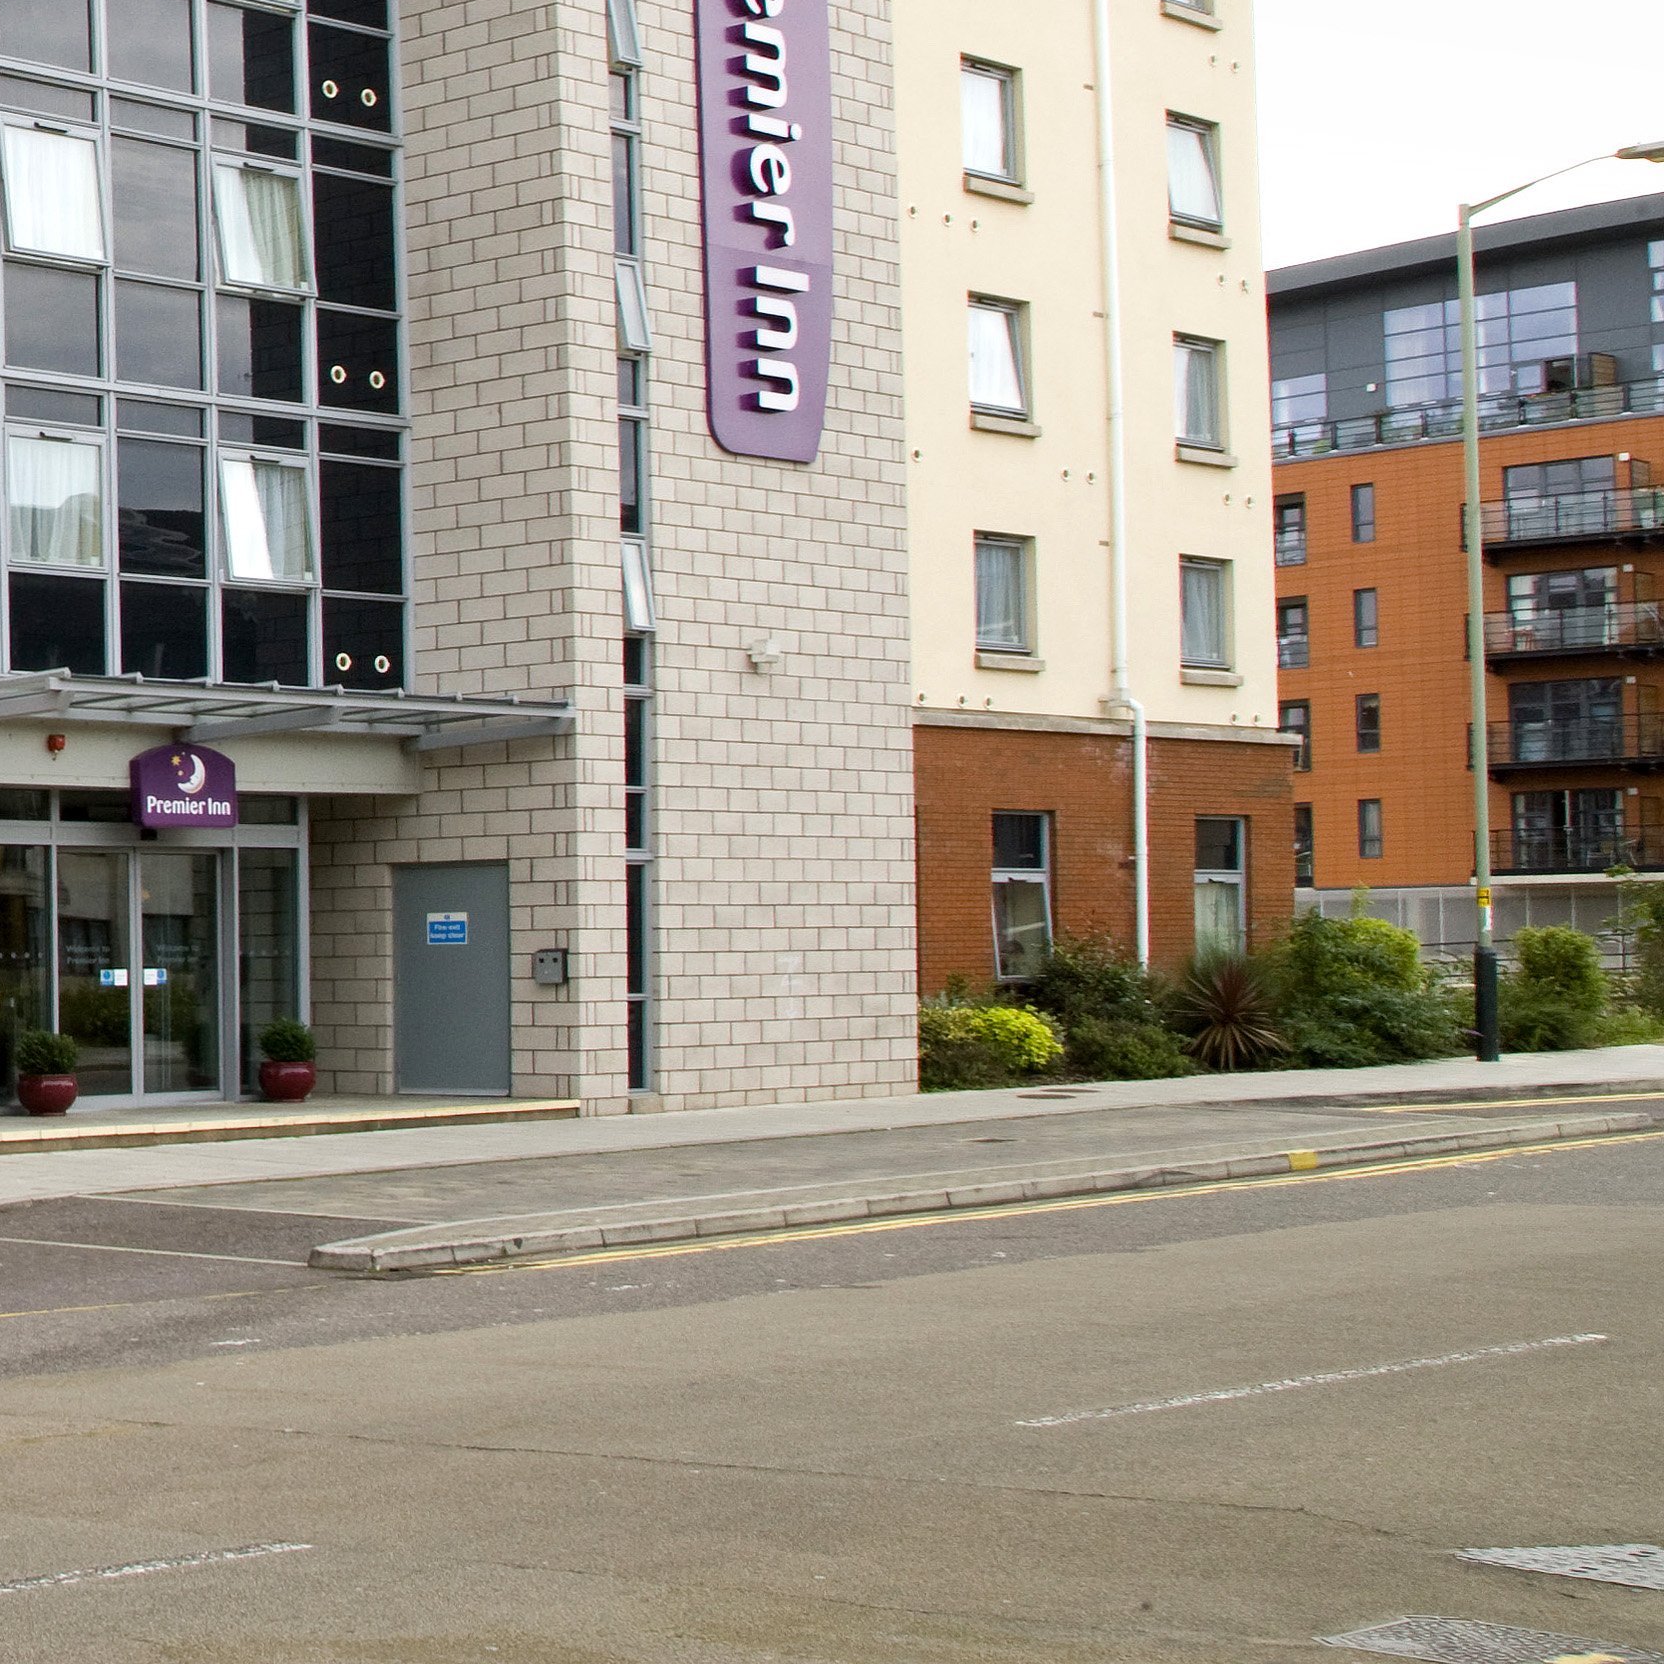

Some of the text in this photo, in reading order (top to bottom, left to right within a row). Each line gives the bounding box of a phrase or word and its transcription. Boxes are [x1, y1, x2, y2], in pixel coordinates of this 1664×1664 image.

[755, 264, 810, 413] Inn
[146, 795, 231, 816] Premier Inn
